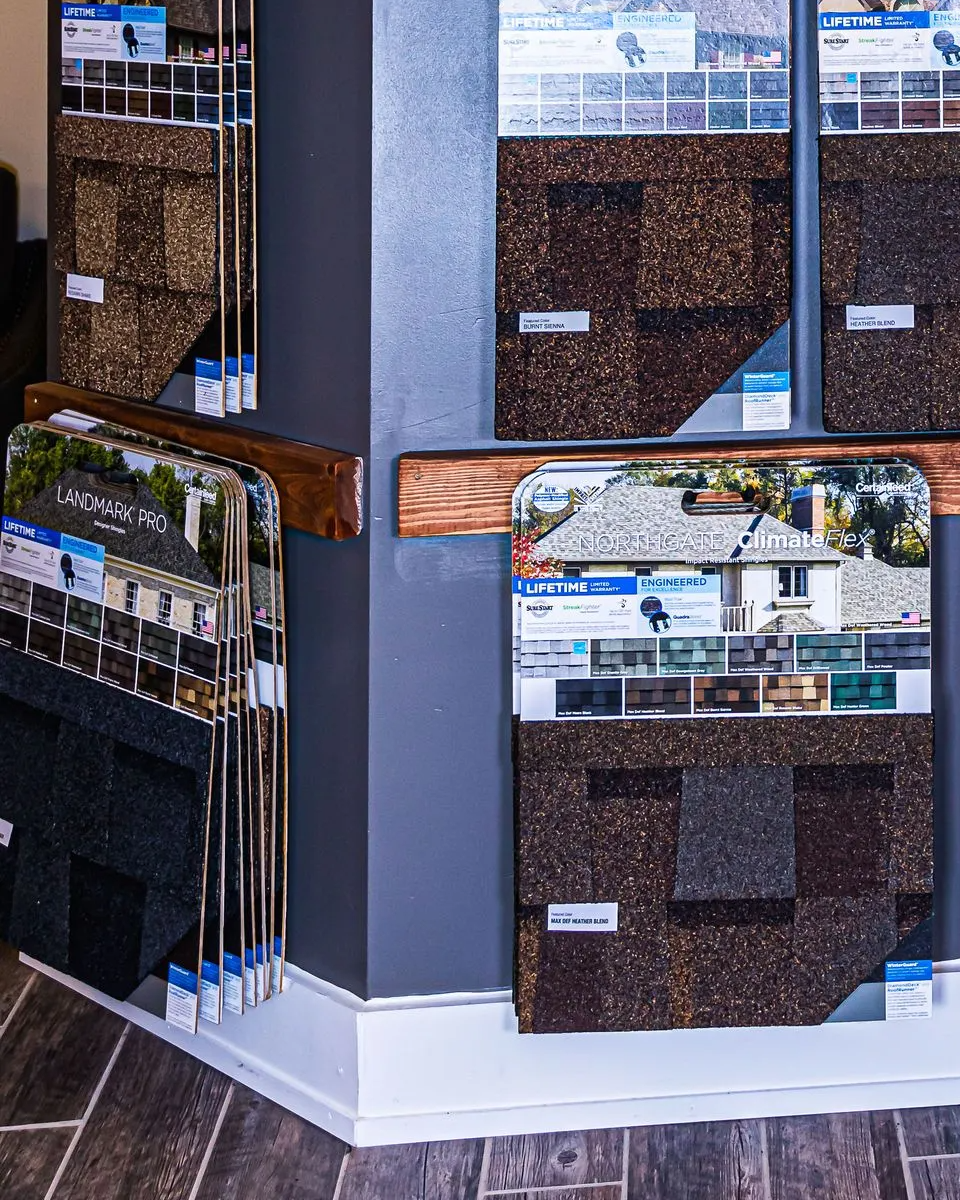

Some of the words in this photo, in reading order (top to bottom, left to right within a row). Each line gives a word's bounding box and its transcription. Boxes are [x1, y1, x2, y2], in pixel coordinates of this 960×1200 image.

[64, 7, 96, 17] LIFETIME
[503, 17, 564, 28] LIFETIME
[617, 15, 682, 23] ENGINEERED
[823, 16, 882, 28] LIFETIME
[184, 482, 216, 500] CertainTeed
[856, 482, 911, 493] CertainTeed
[57, 486, 133, 524] LANDMARK
[139, 509, 167, 534] PRO
[4, 521, 35, 538] LIFETIME
[578, 531, 724, 553] NORTHGATE
[738, 529, 871, 550] ClimateFlex
[686, 557, 707, 565] Impact
[740, 556, 768, 564] Shingles
[526, 582, 587, 594] LIFETIME
[641, 578, 707, 587] ENGINEERED
